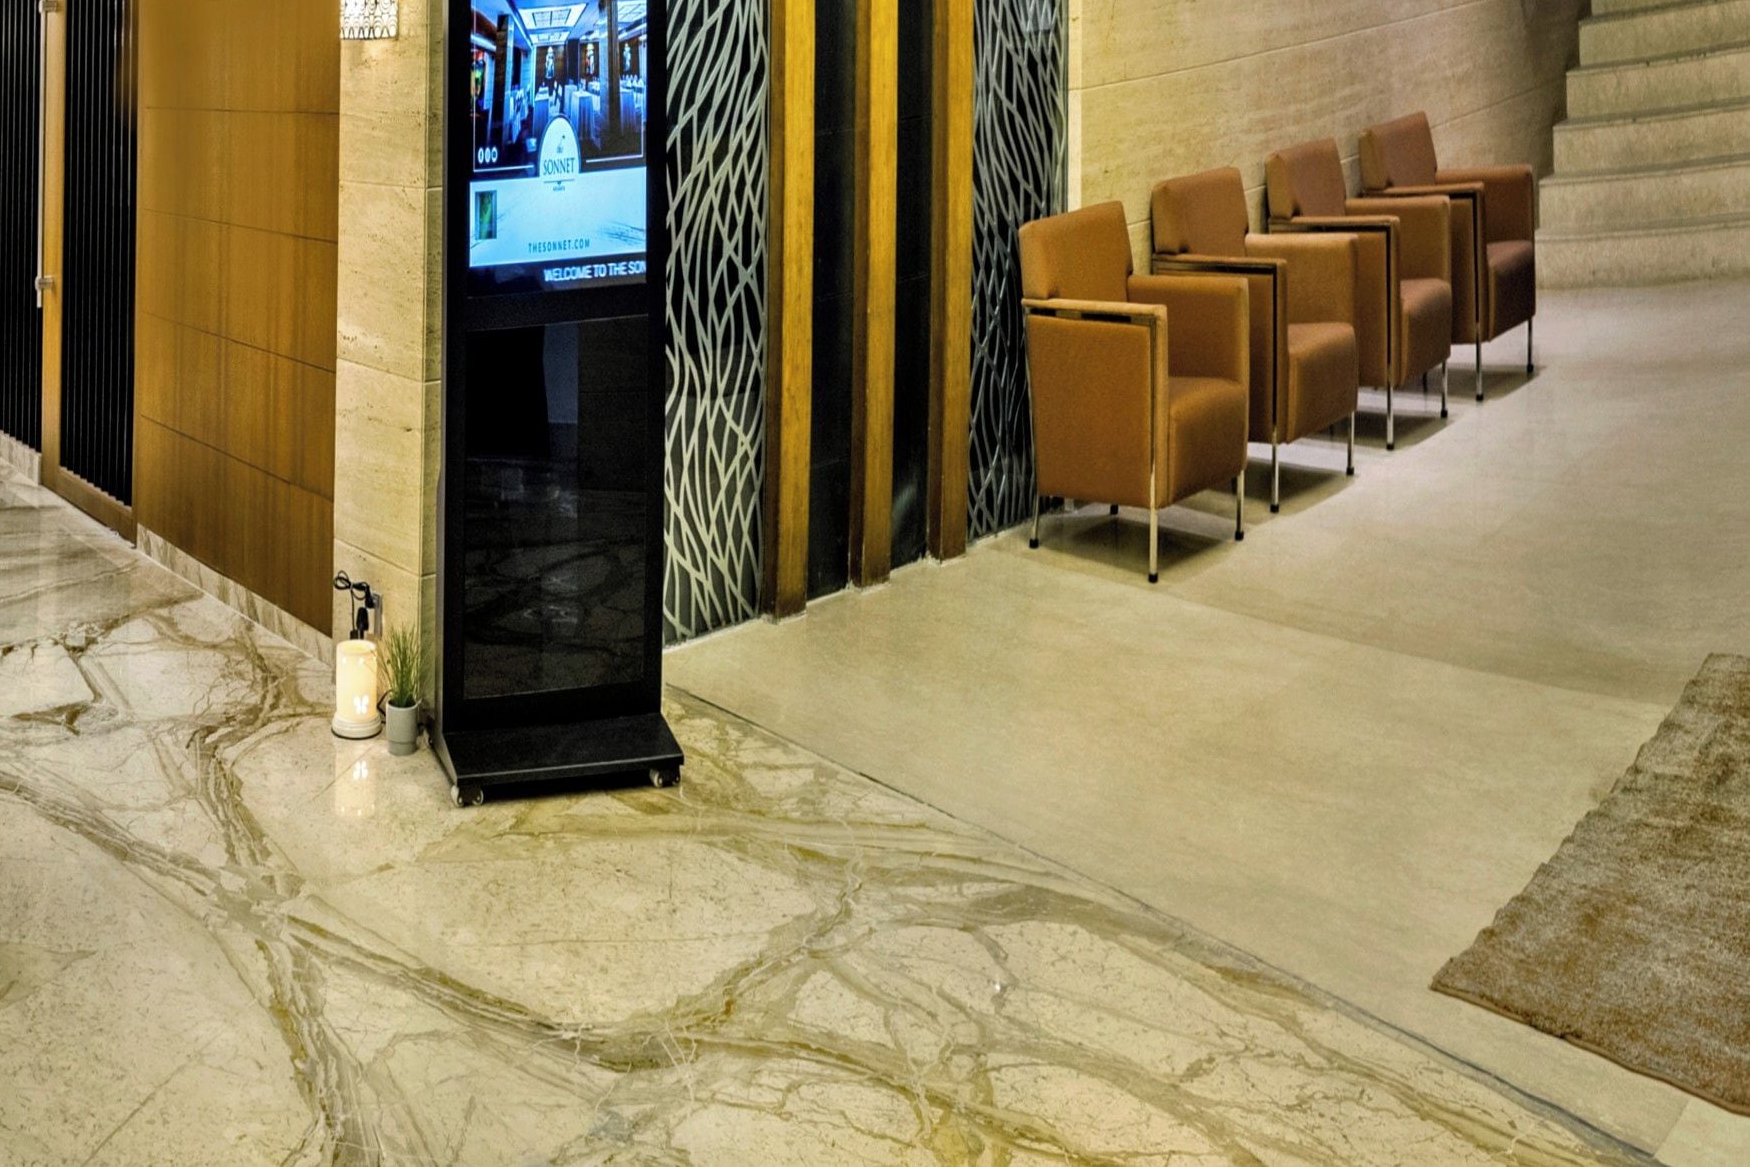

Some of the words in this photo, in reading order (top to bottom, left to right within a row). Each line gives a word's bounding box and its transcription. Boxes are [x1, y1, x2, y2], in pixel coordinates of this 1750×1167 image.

[543, 157, 575, 175] SONNET
[528, 238, 590, 254] THESONNET.COM
[543, 265, 592, 282] WELCOME
[593, 263, 607, 278] TO
[608, 261, 628, 276] THE
